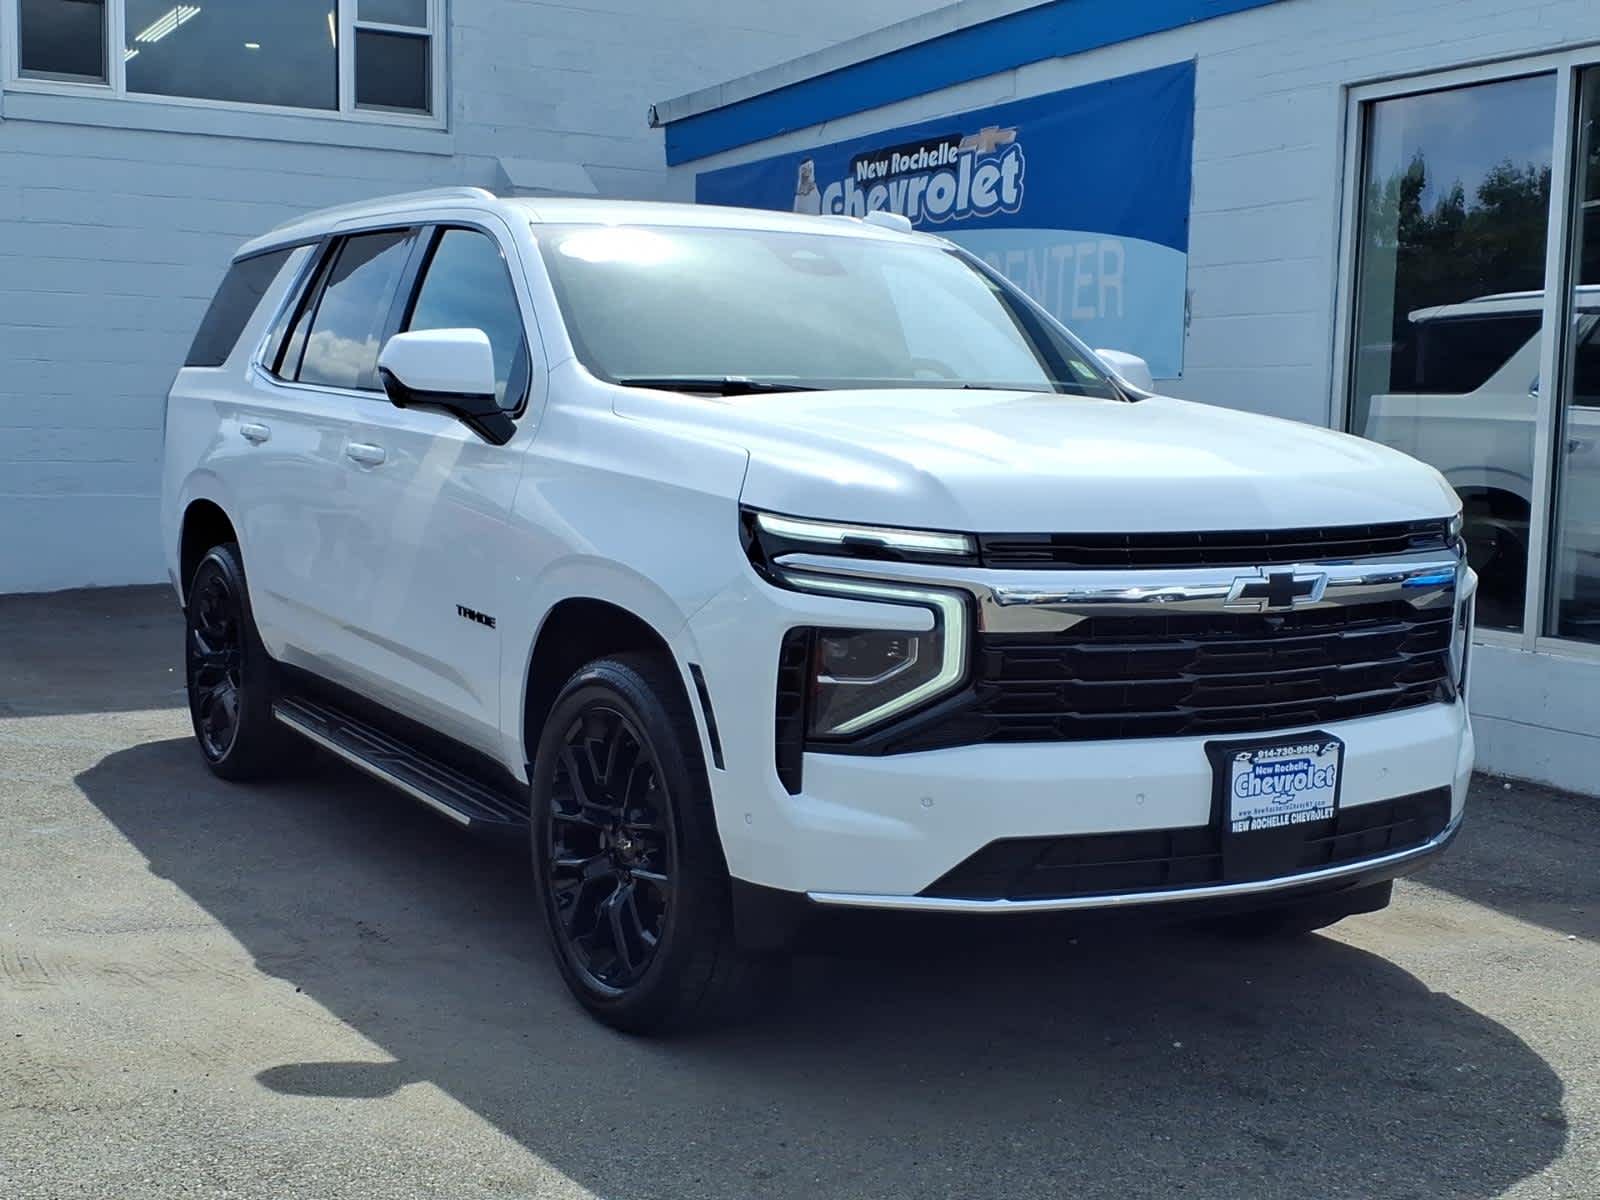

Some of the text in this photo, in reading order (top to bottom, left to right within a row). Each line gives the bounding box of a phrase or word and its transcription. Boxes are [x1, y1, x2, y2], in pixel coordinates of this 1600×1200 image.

[856, 142, 958, 181] New Rochelle
[456, 604, 496, 629] TAHOE
[1235, 764, 1335, 798] Chevrolet
[1256, 761, 1308, 775] New Rochelle
[1232, 807, 1335, 833] NEW ROCHELLE CHEVROLET
